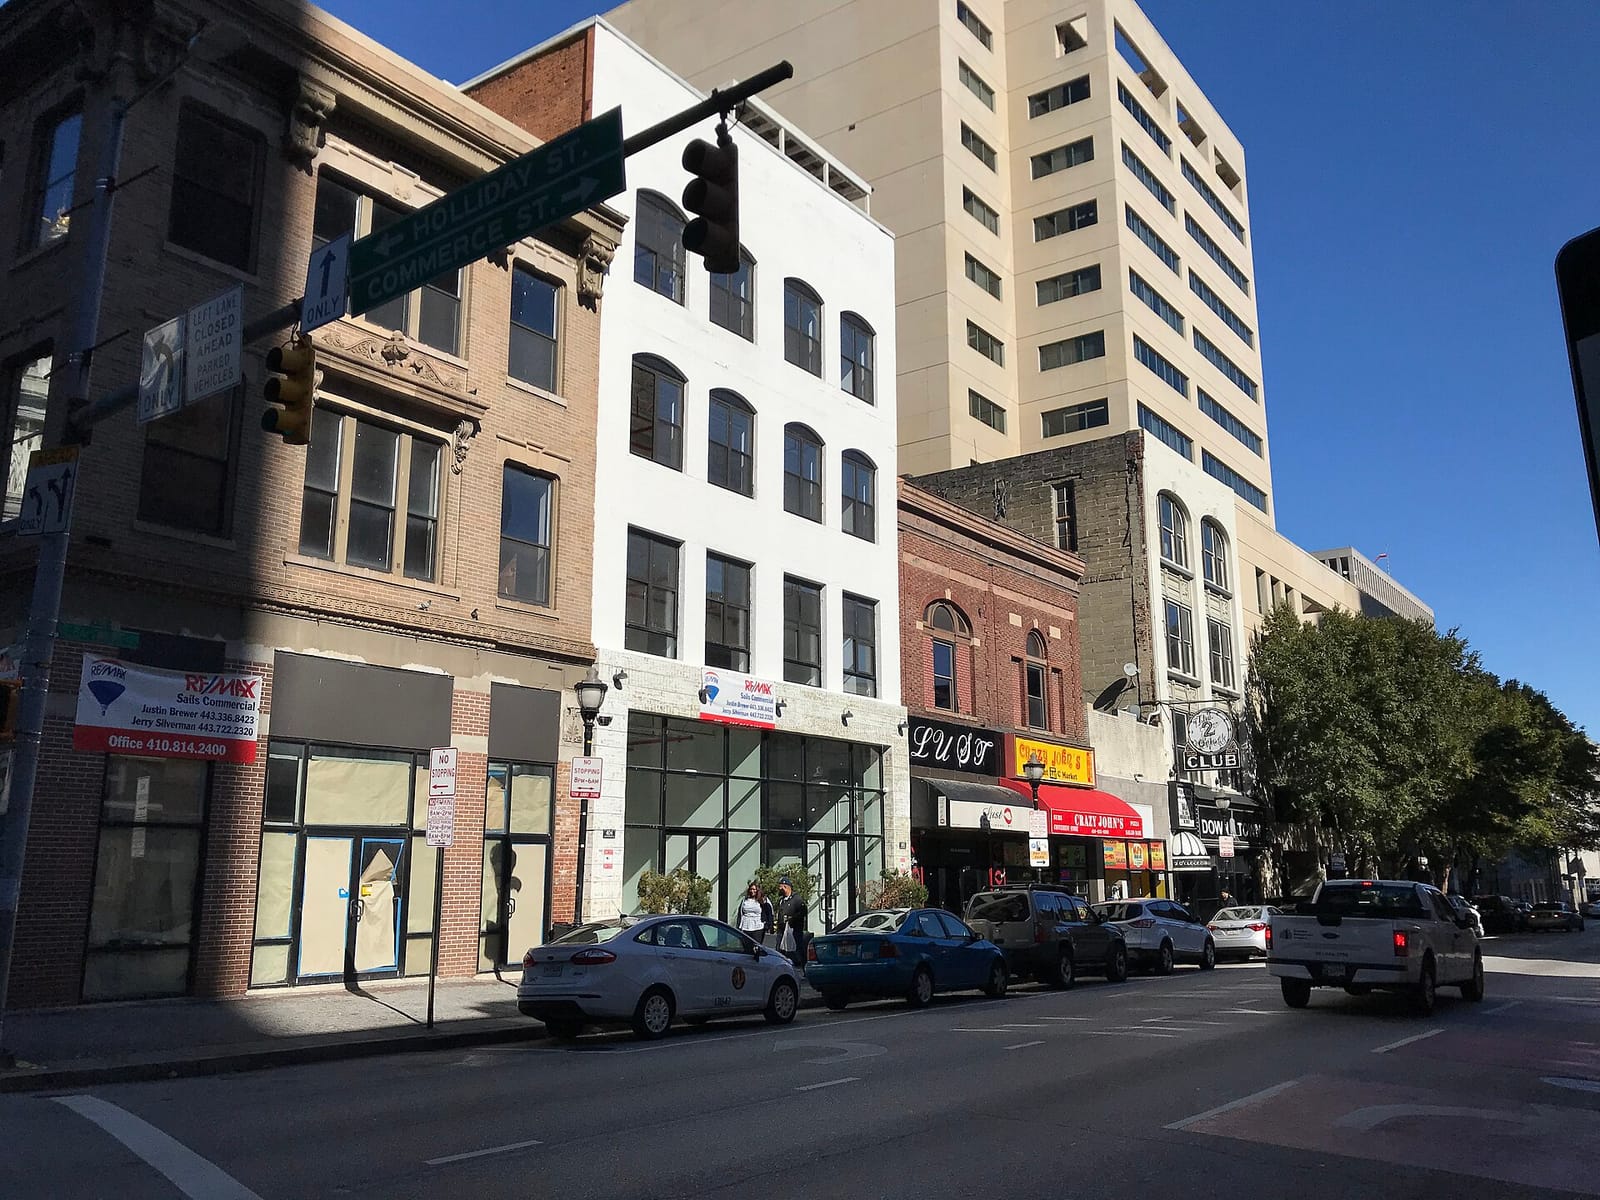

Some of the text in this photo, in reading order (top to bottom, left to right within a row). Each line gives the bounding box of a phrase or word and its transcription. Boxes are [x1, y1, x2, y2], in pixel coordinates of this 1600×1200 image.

[414, 138, 588, 241] HOLLIDAY ST.
[367, 199, 558, 299] COMMERCE ST.
[193, 293, 237, 326] LEFT LANE
[307, 296, 340, 324] ONLY
[195, 313, 235, 342] CLOSED
[198, 332, 233, 356] AHEAD
[197, 352, 230, 377] PARKED
[193, 366, 233, 393] VEHICLES
[144, 386, 175, 412] ONLY
[91, 663, 127, 680] RE/MAX
[185, 674, 257, 699] RE/MAX
[745, 680, 772, 695] RE/MAX
[176, 693, 256, 712] Sails Commercial
[141, 704, 255, 724] Justin Brewer 443.336.8423
[131, 716, 254, 736] Jerry Silverman 443.722.2320
[1202, 721, 1216, 737] 2
[108, 735, 227, 756] Office 410.814.2400
[911, 725, 994, 768] LUST
[438, 754, 449, 765] NO
[1187, 755, 1237, 768] CLUB
[432, 768, 455, 778] STOPPING
[1074, 814, 1097, 828] CRAZY
[1098, 816, 1124, 830] JOHN'S
